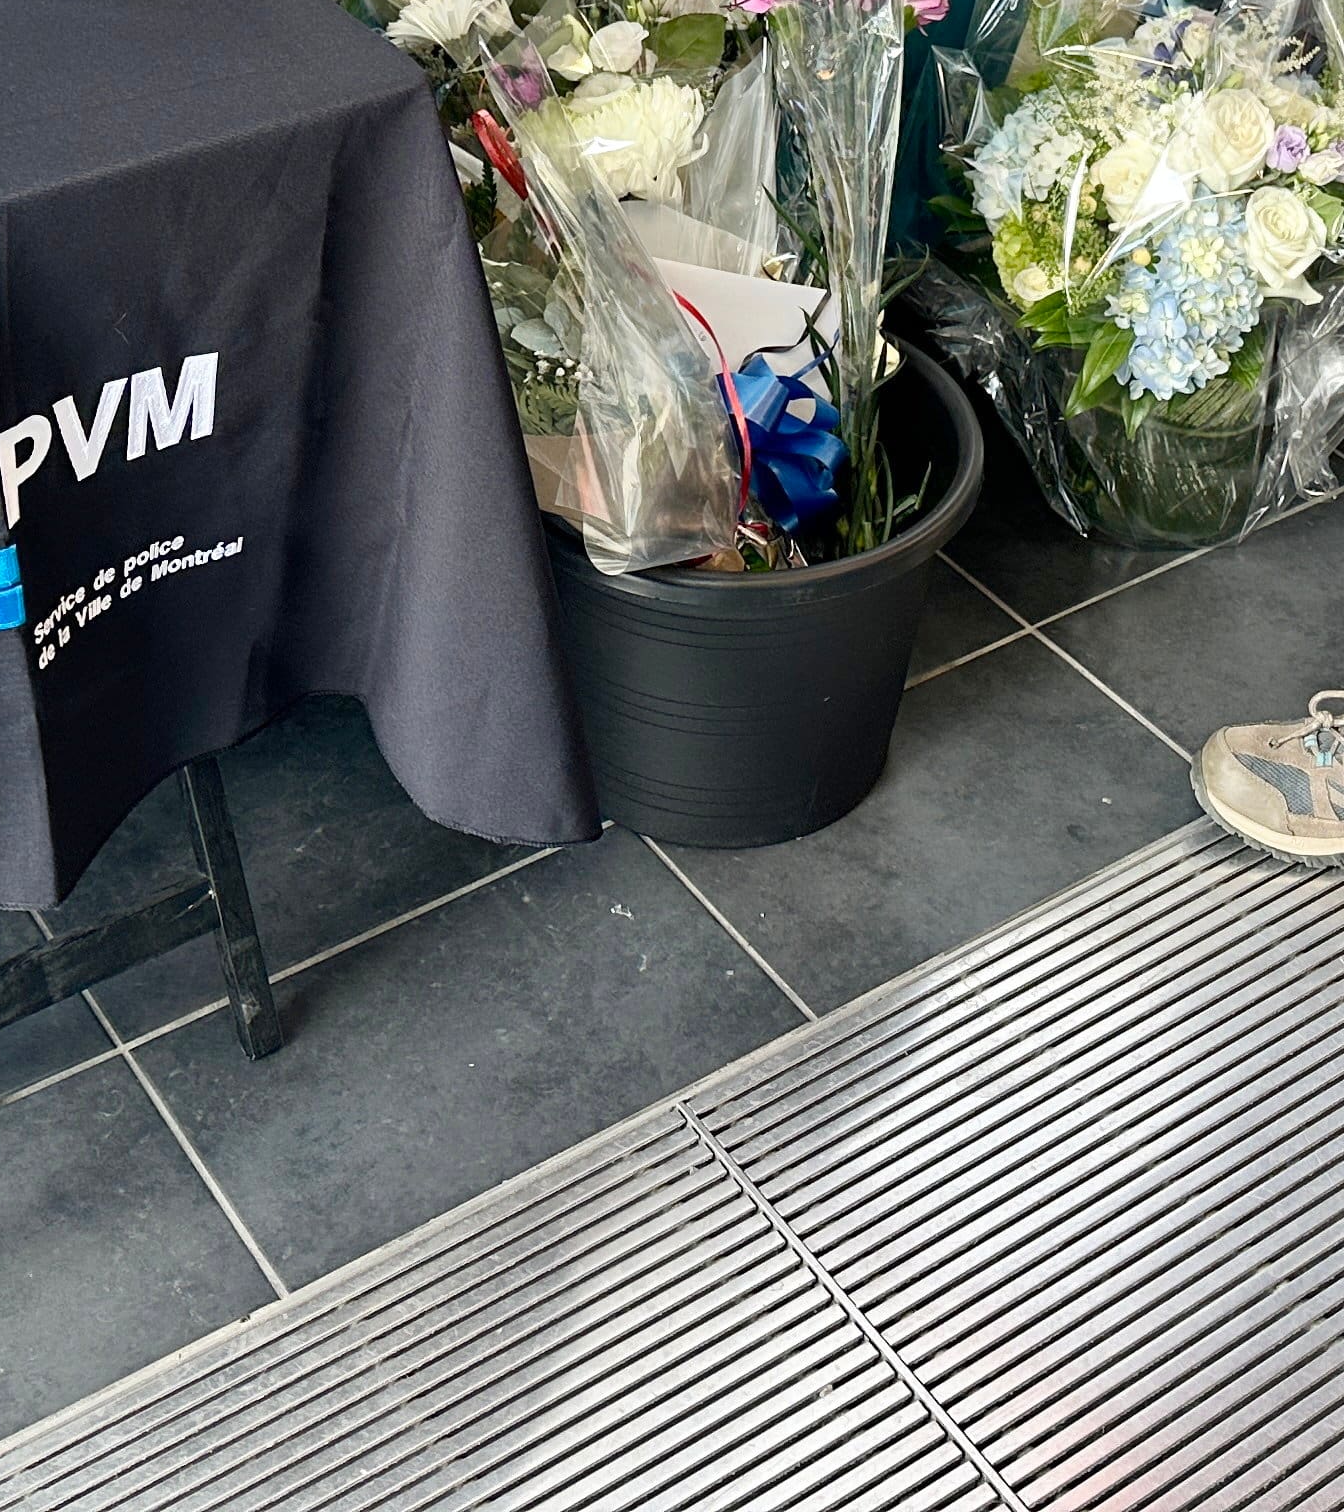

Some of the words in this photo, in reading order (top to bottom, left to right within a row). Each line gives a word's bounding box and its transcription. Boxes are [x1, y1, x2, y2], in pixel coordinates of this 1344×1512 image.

[34, 586, 86, 644] Service
[93, 567, 115, 590] de
[124, 535, 184, 575] police
[39, 644, 55, 669] de
[58, 625, 70, 647] la
[75, 594, 112, 627] Ville
[120, 576, 143, 598] de
[151, 536, 243, 581] Montréal
